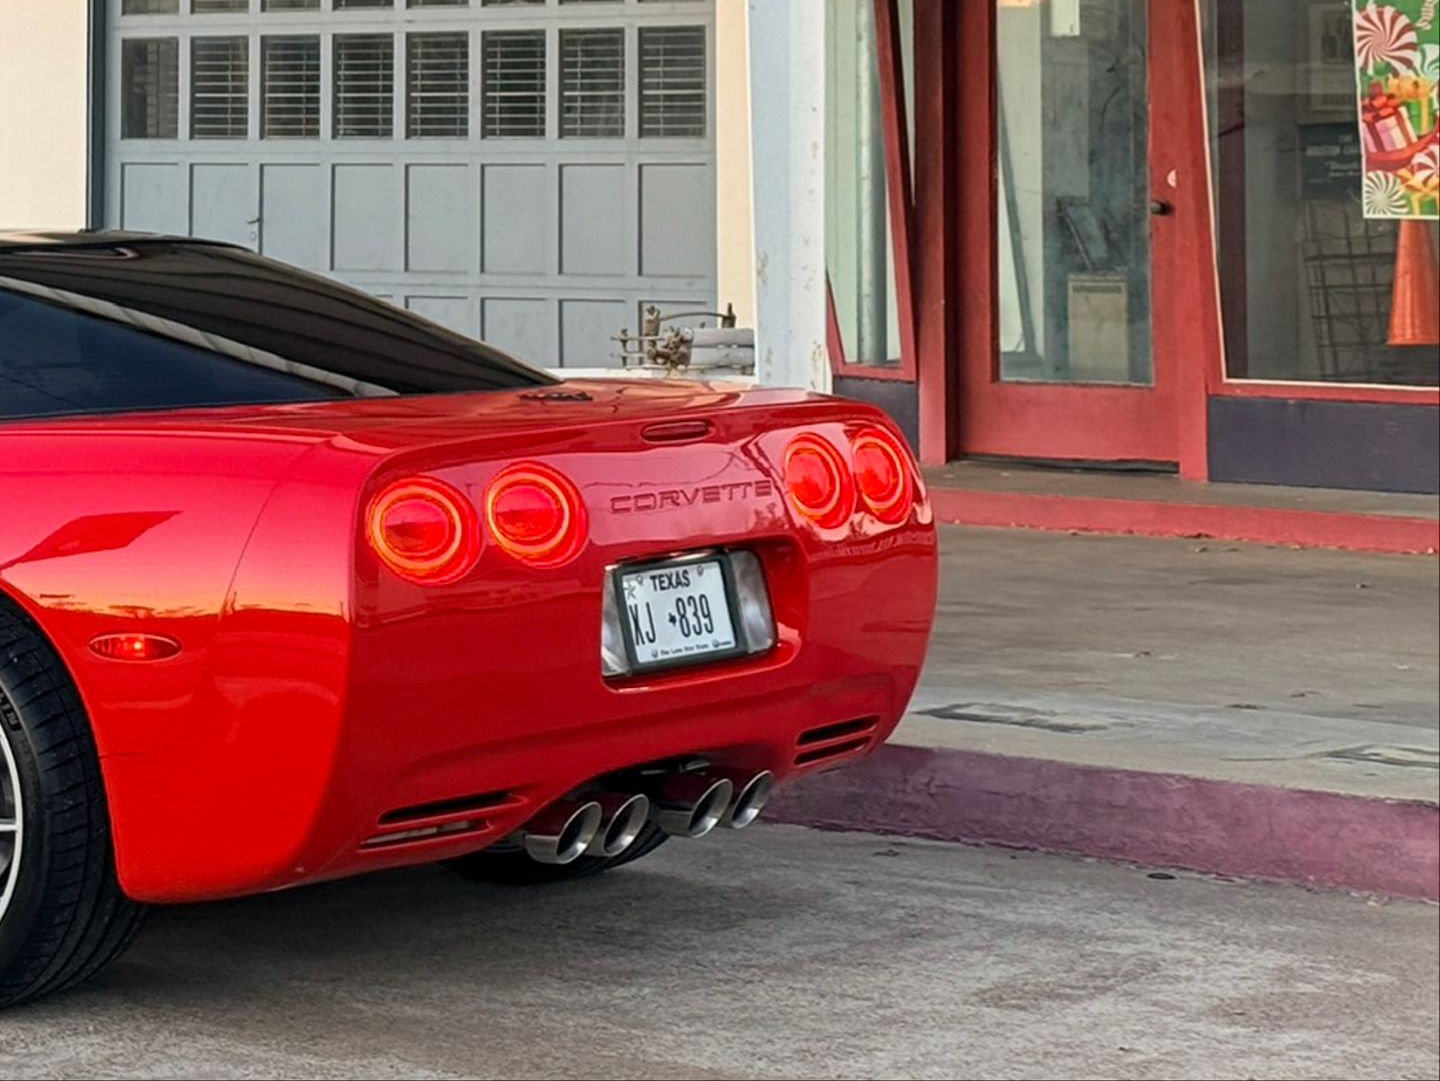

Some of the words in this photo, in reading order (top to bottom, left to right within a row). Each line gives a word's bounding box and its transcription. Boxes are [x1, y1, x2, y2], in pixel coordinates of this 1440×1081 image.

[610, 479, 772, 514] CORVETTE
[650, 568, 691, 592] TEXAS
[629, 601, 657, 646] XJ
[675, 593, 714, 638] 839
